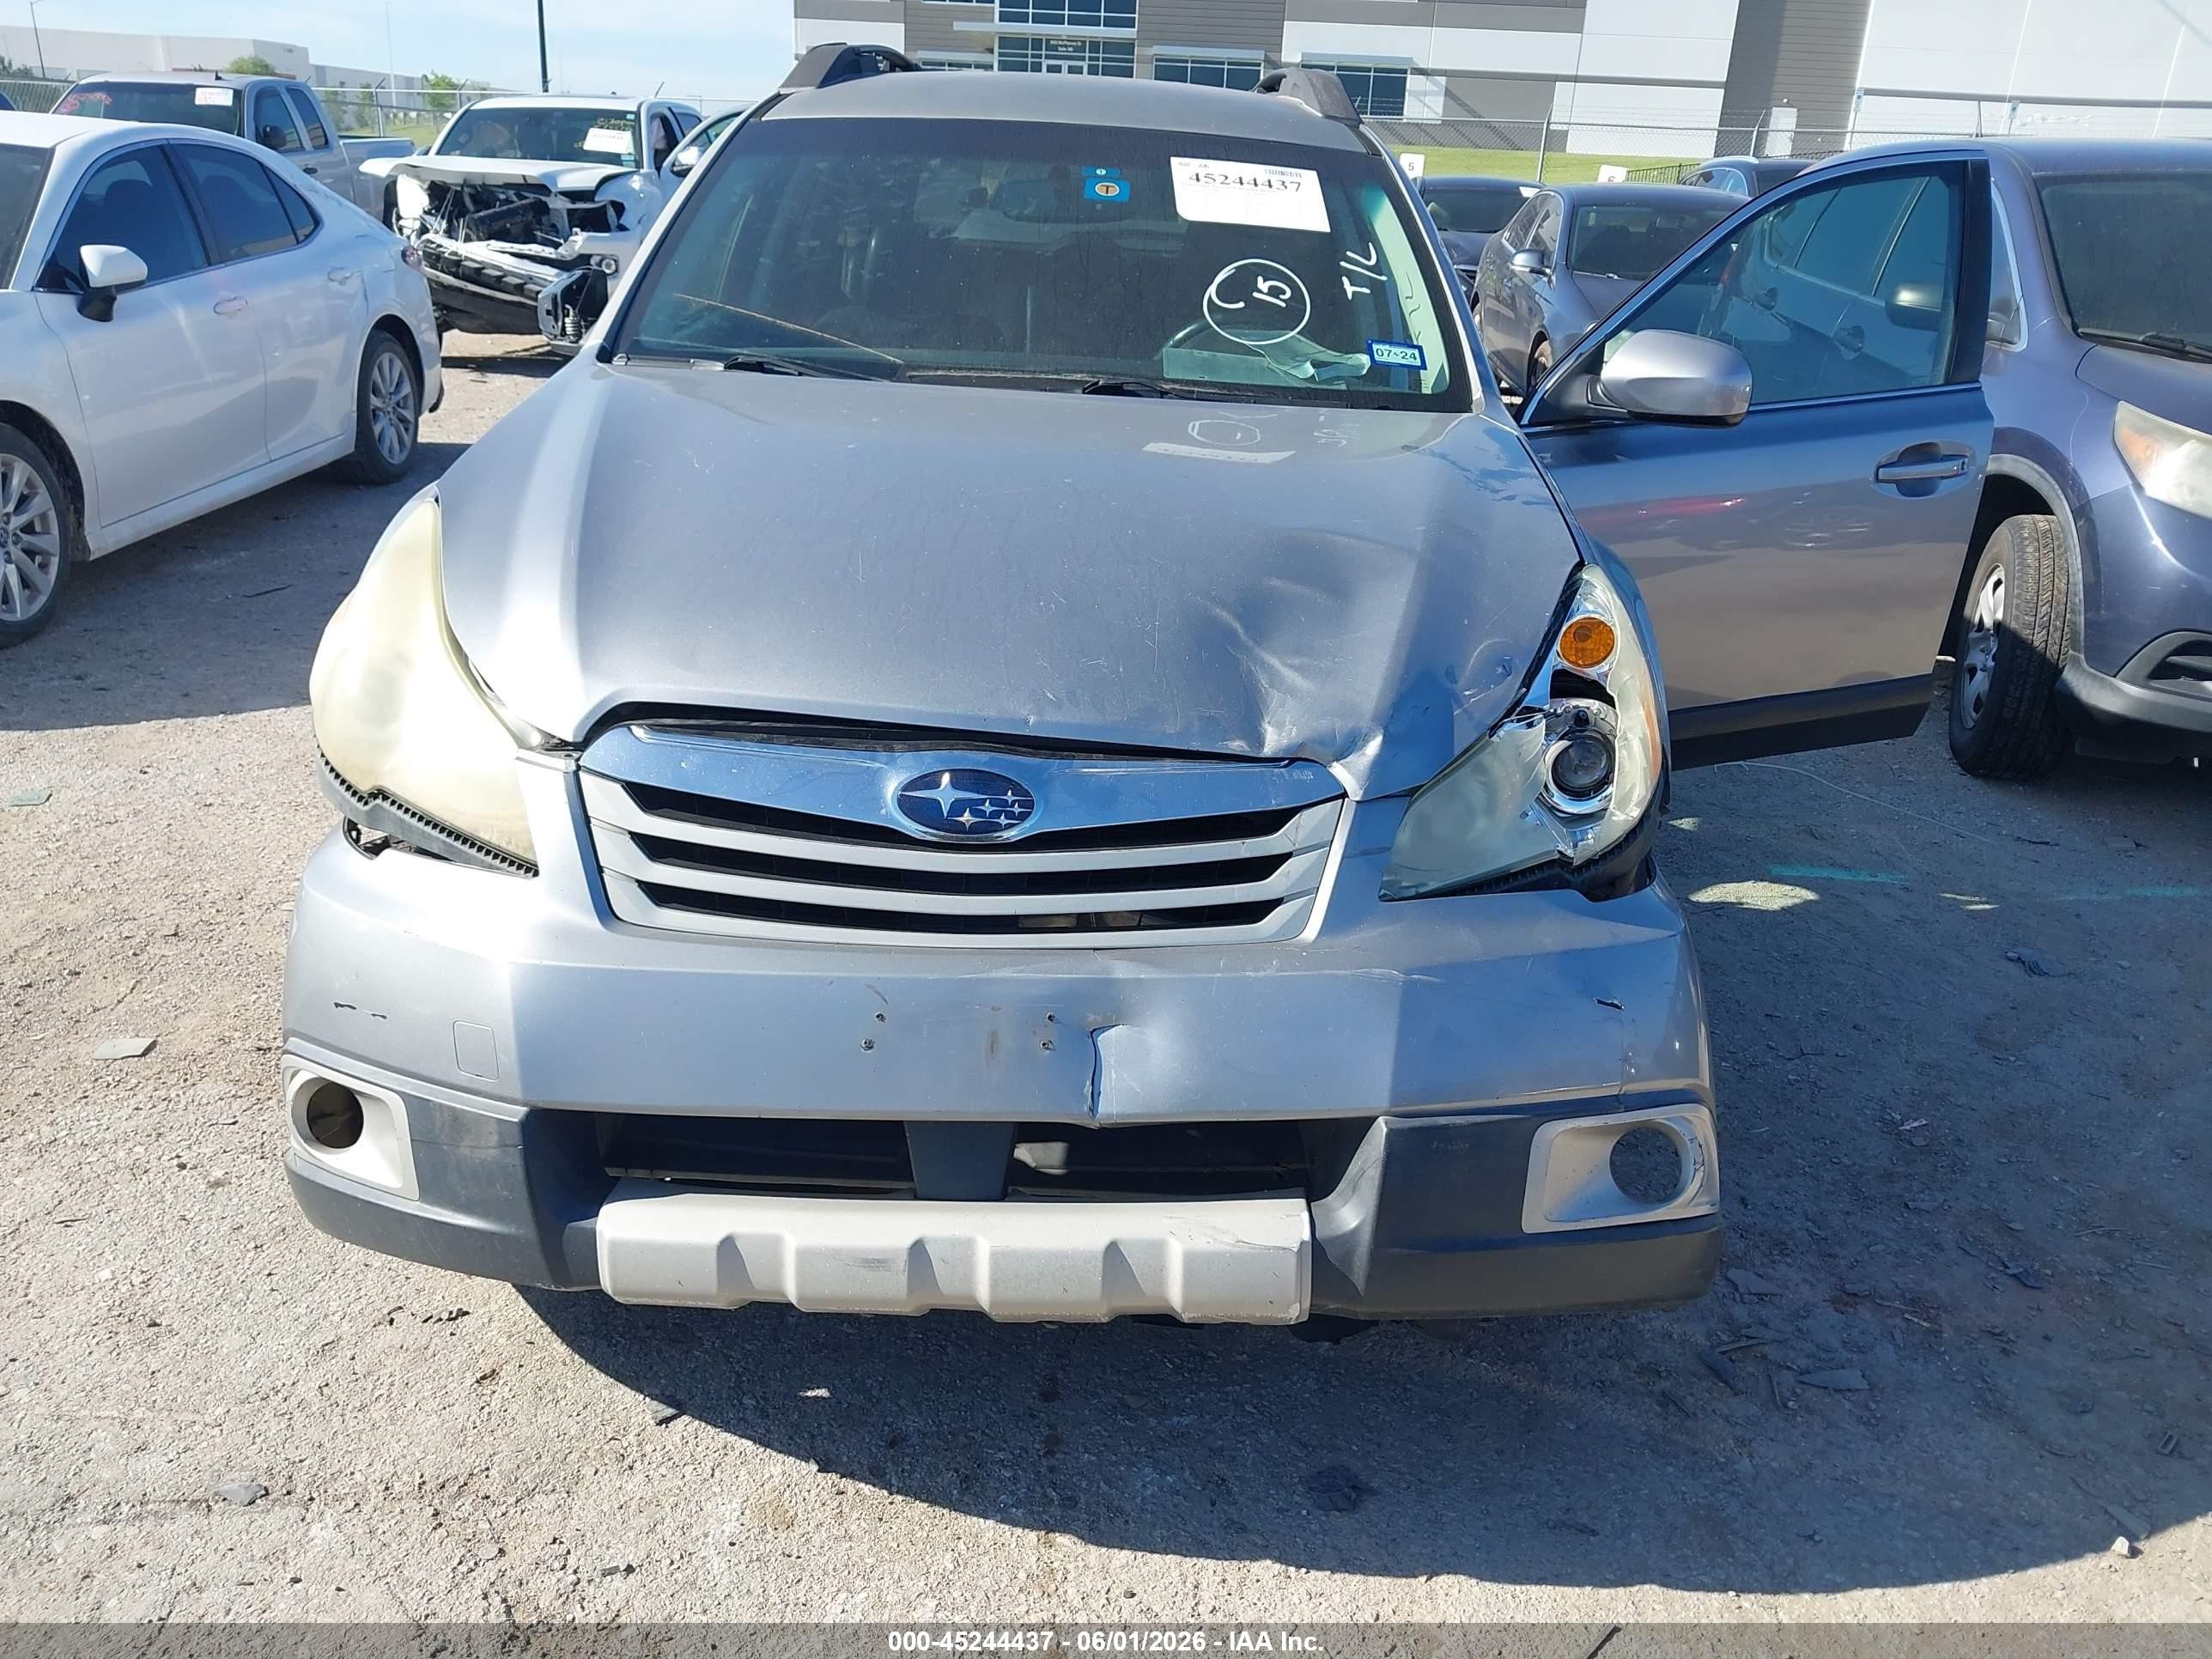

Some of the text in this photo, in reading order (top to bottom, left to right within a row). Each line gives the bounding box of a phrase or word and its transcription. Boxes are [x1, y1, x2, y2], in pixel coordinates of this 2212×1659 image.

[1408, 161, 1415, 172] 5
[1188, 172, 1302, 192] 45244437
[1252, 275, 1291, 307] 15
